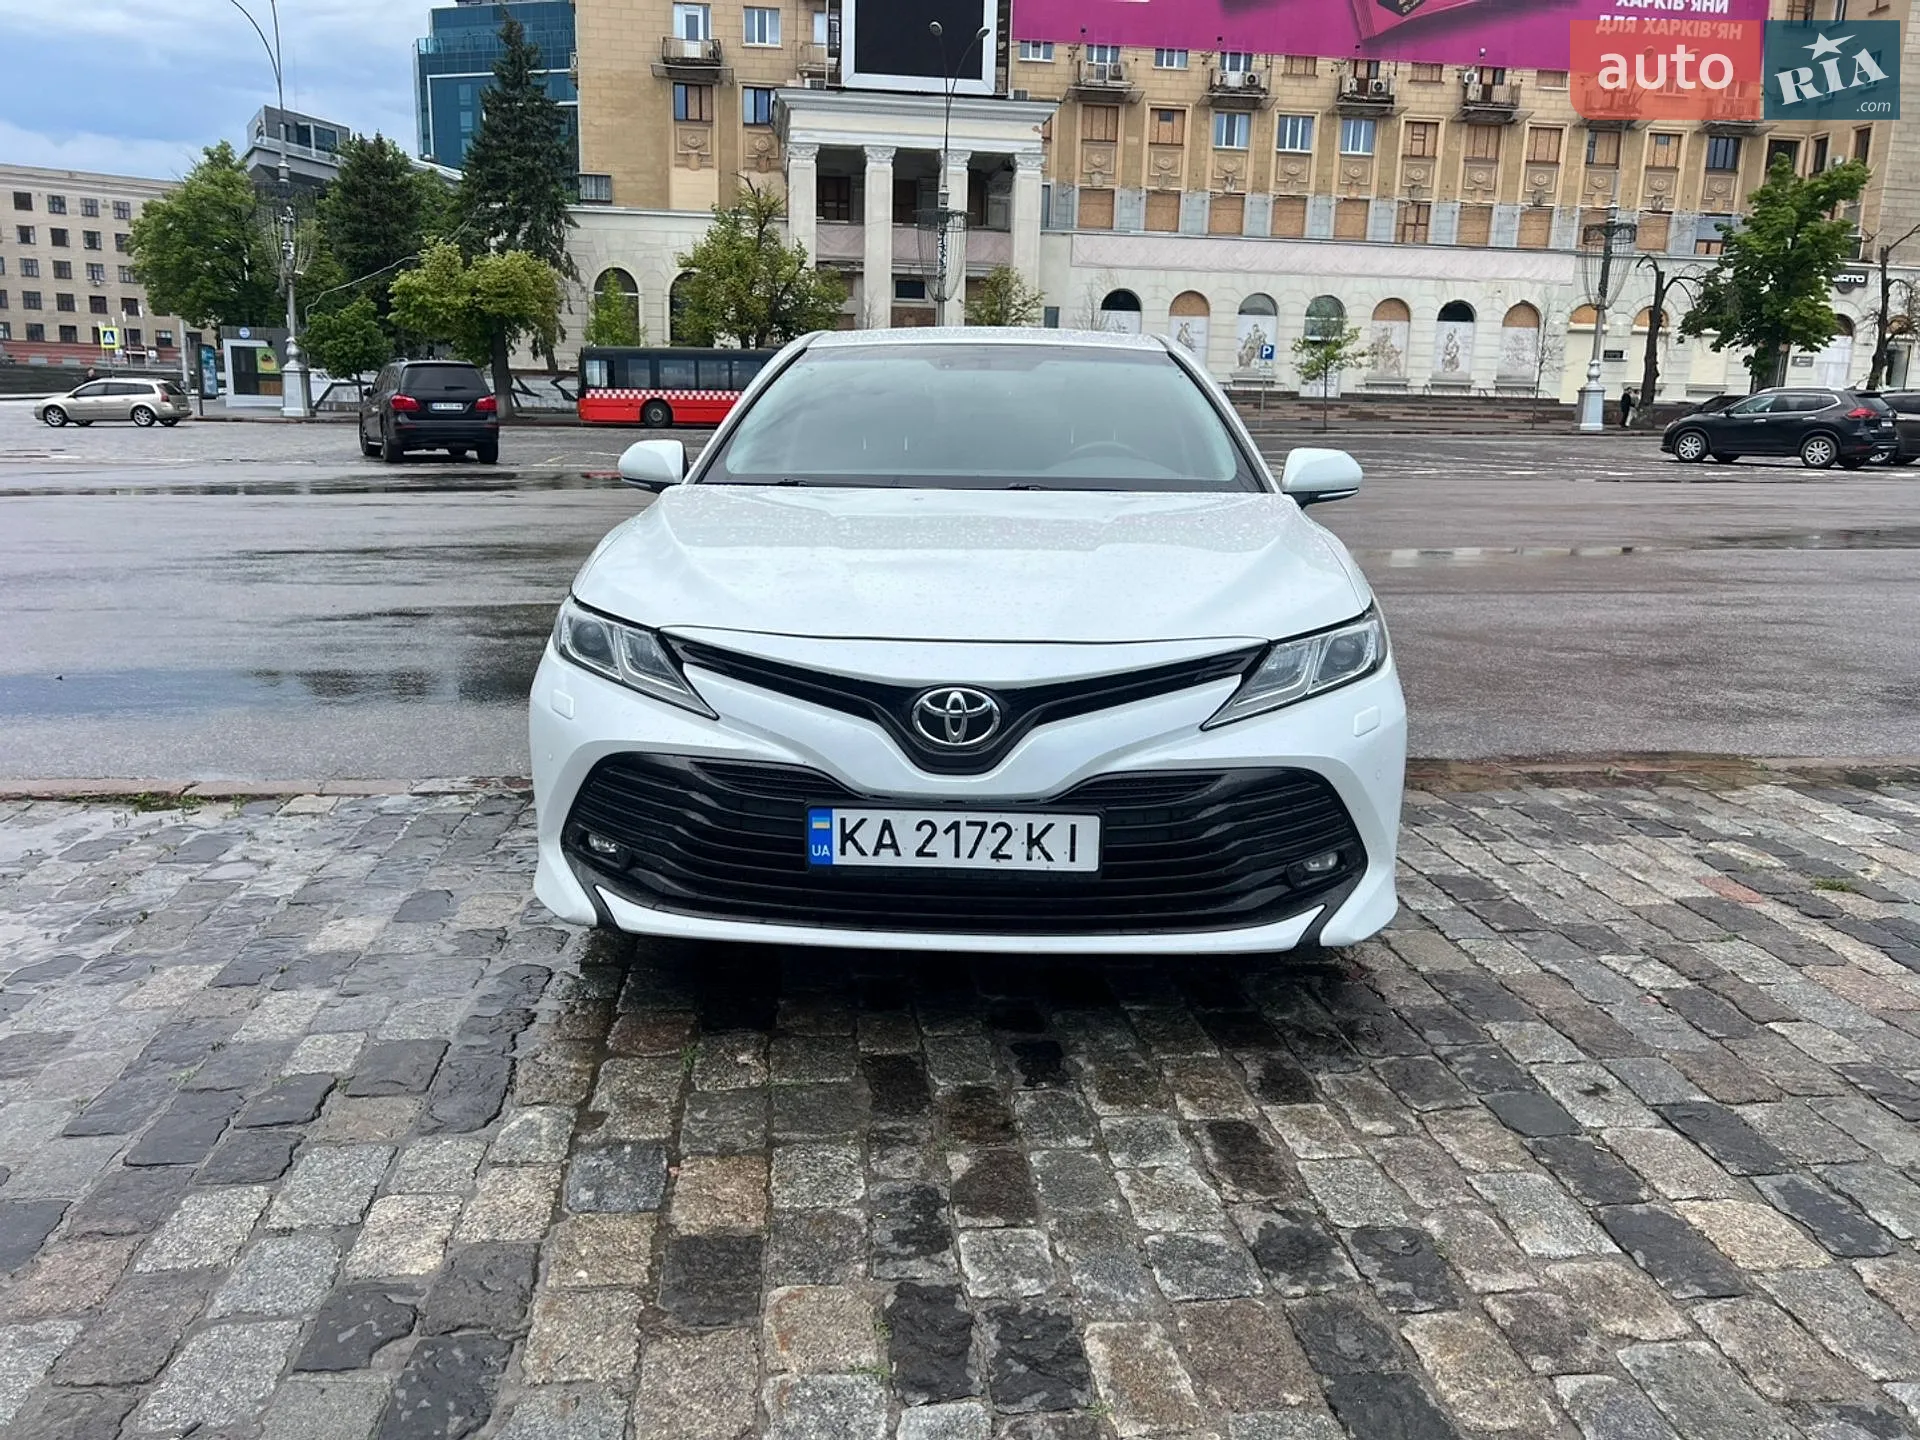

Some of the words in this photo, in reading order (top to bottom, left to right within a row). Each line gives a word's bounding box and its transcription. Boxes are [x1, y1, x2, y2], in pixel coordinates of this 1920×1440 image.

[1616, 0, 1729, 14] РКІВЯНИ
[1595, 15, 1638, 34] ДЛЯ
[1262, 345, 1272, 358] P
[839, 817, 902, 857] KA
[914, 819, 1013, 860] 2172
[1026, 822, 1077, 863] KI
[812, 845, 830, 857] UA
